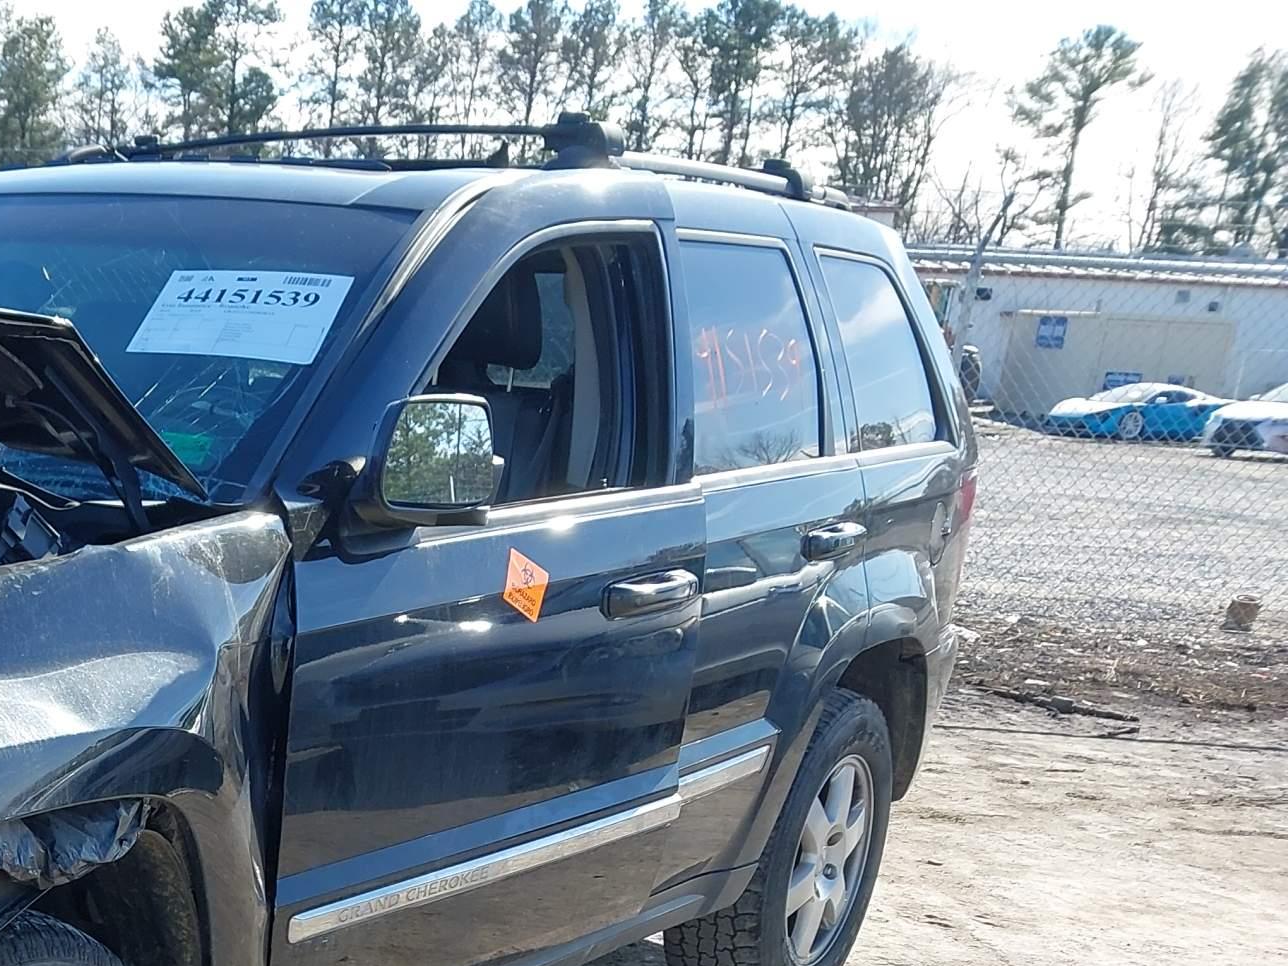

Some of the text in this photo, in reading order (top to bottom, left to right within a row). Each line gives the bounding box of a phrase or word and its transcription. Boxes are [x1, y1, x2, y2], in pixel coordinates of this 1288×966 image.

[177, 287, 321, 308] 44151539
[337, 866, 489, 923] GRAND CHEROKEE
